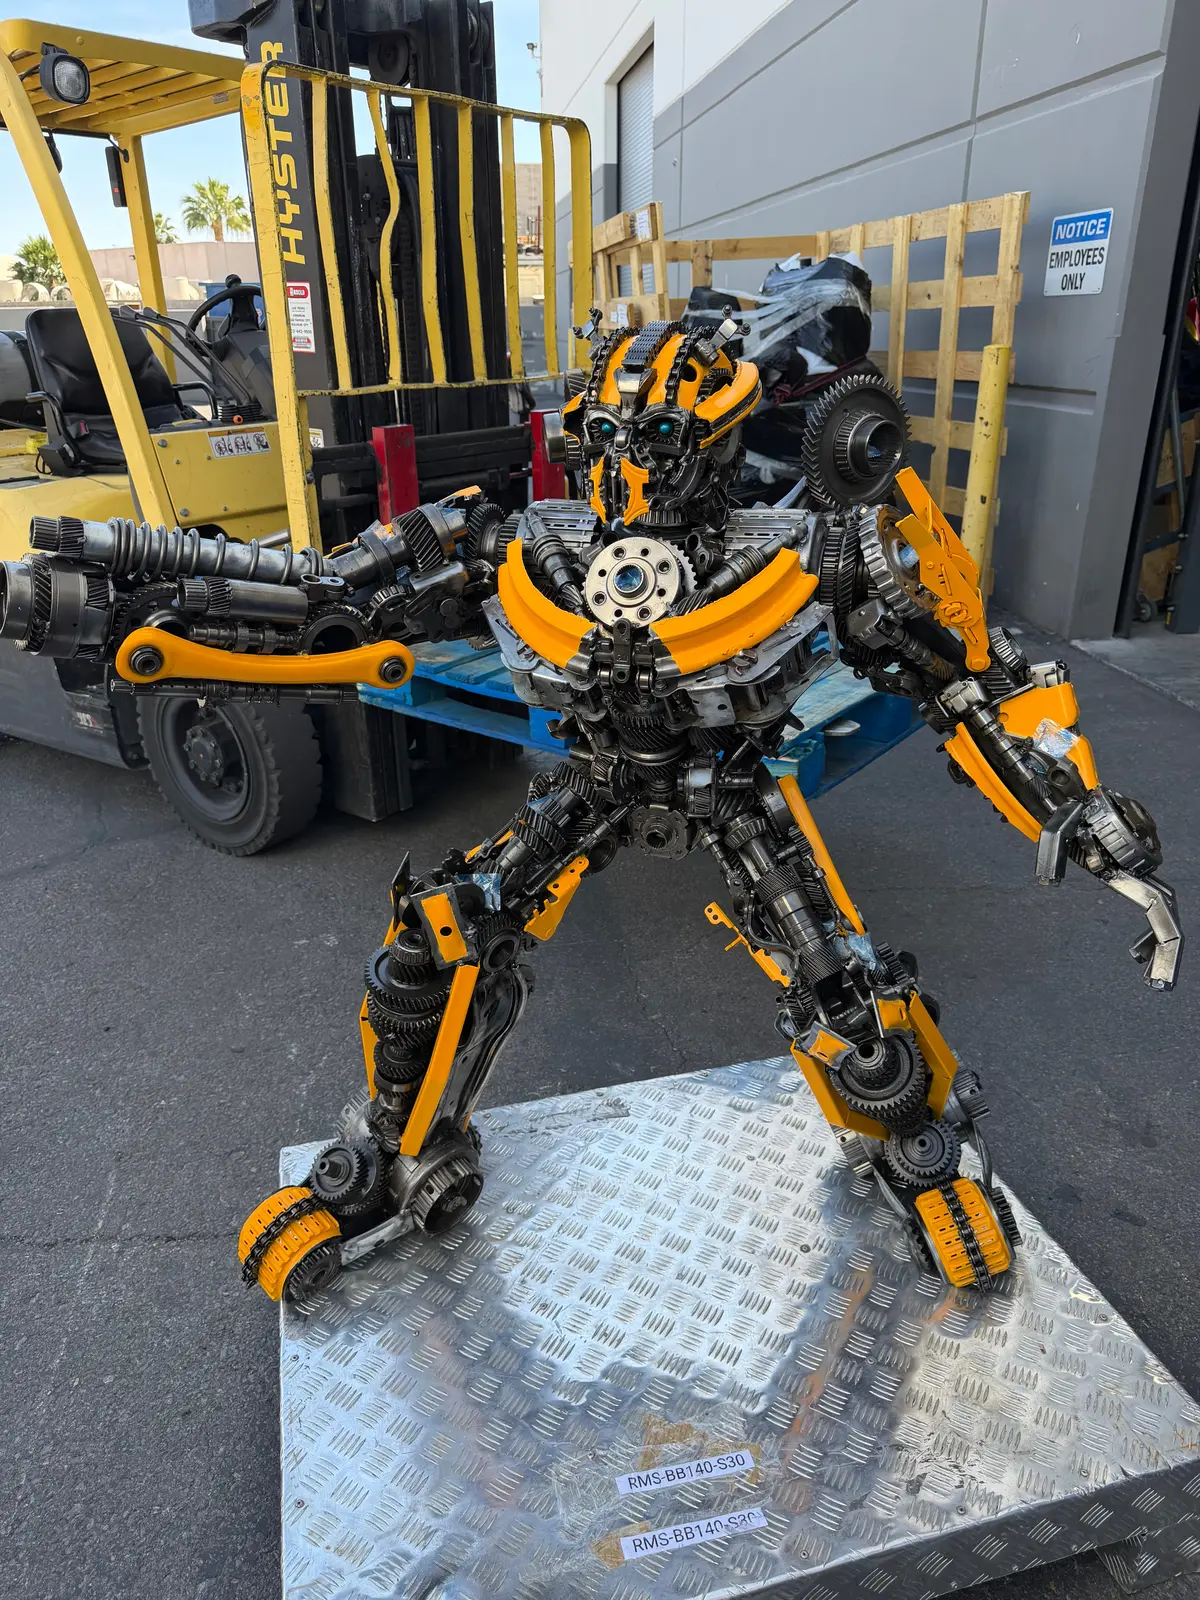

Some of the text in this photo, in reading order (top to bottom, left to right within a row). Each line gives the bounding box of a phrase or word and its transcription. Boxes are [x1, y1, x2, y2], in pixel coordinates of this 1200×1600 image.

[261, 40, 306, 265] HYSTER
[1055, 218, 1107, 240] NOTICE
[1049, 246, 1105, 269] EMPLOYEES
[1061, 272, 1086, 291] ONLY
[628, 1453, 745, 1490] RMS-BB140-S30
